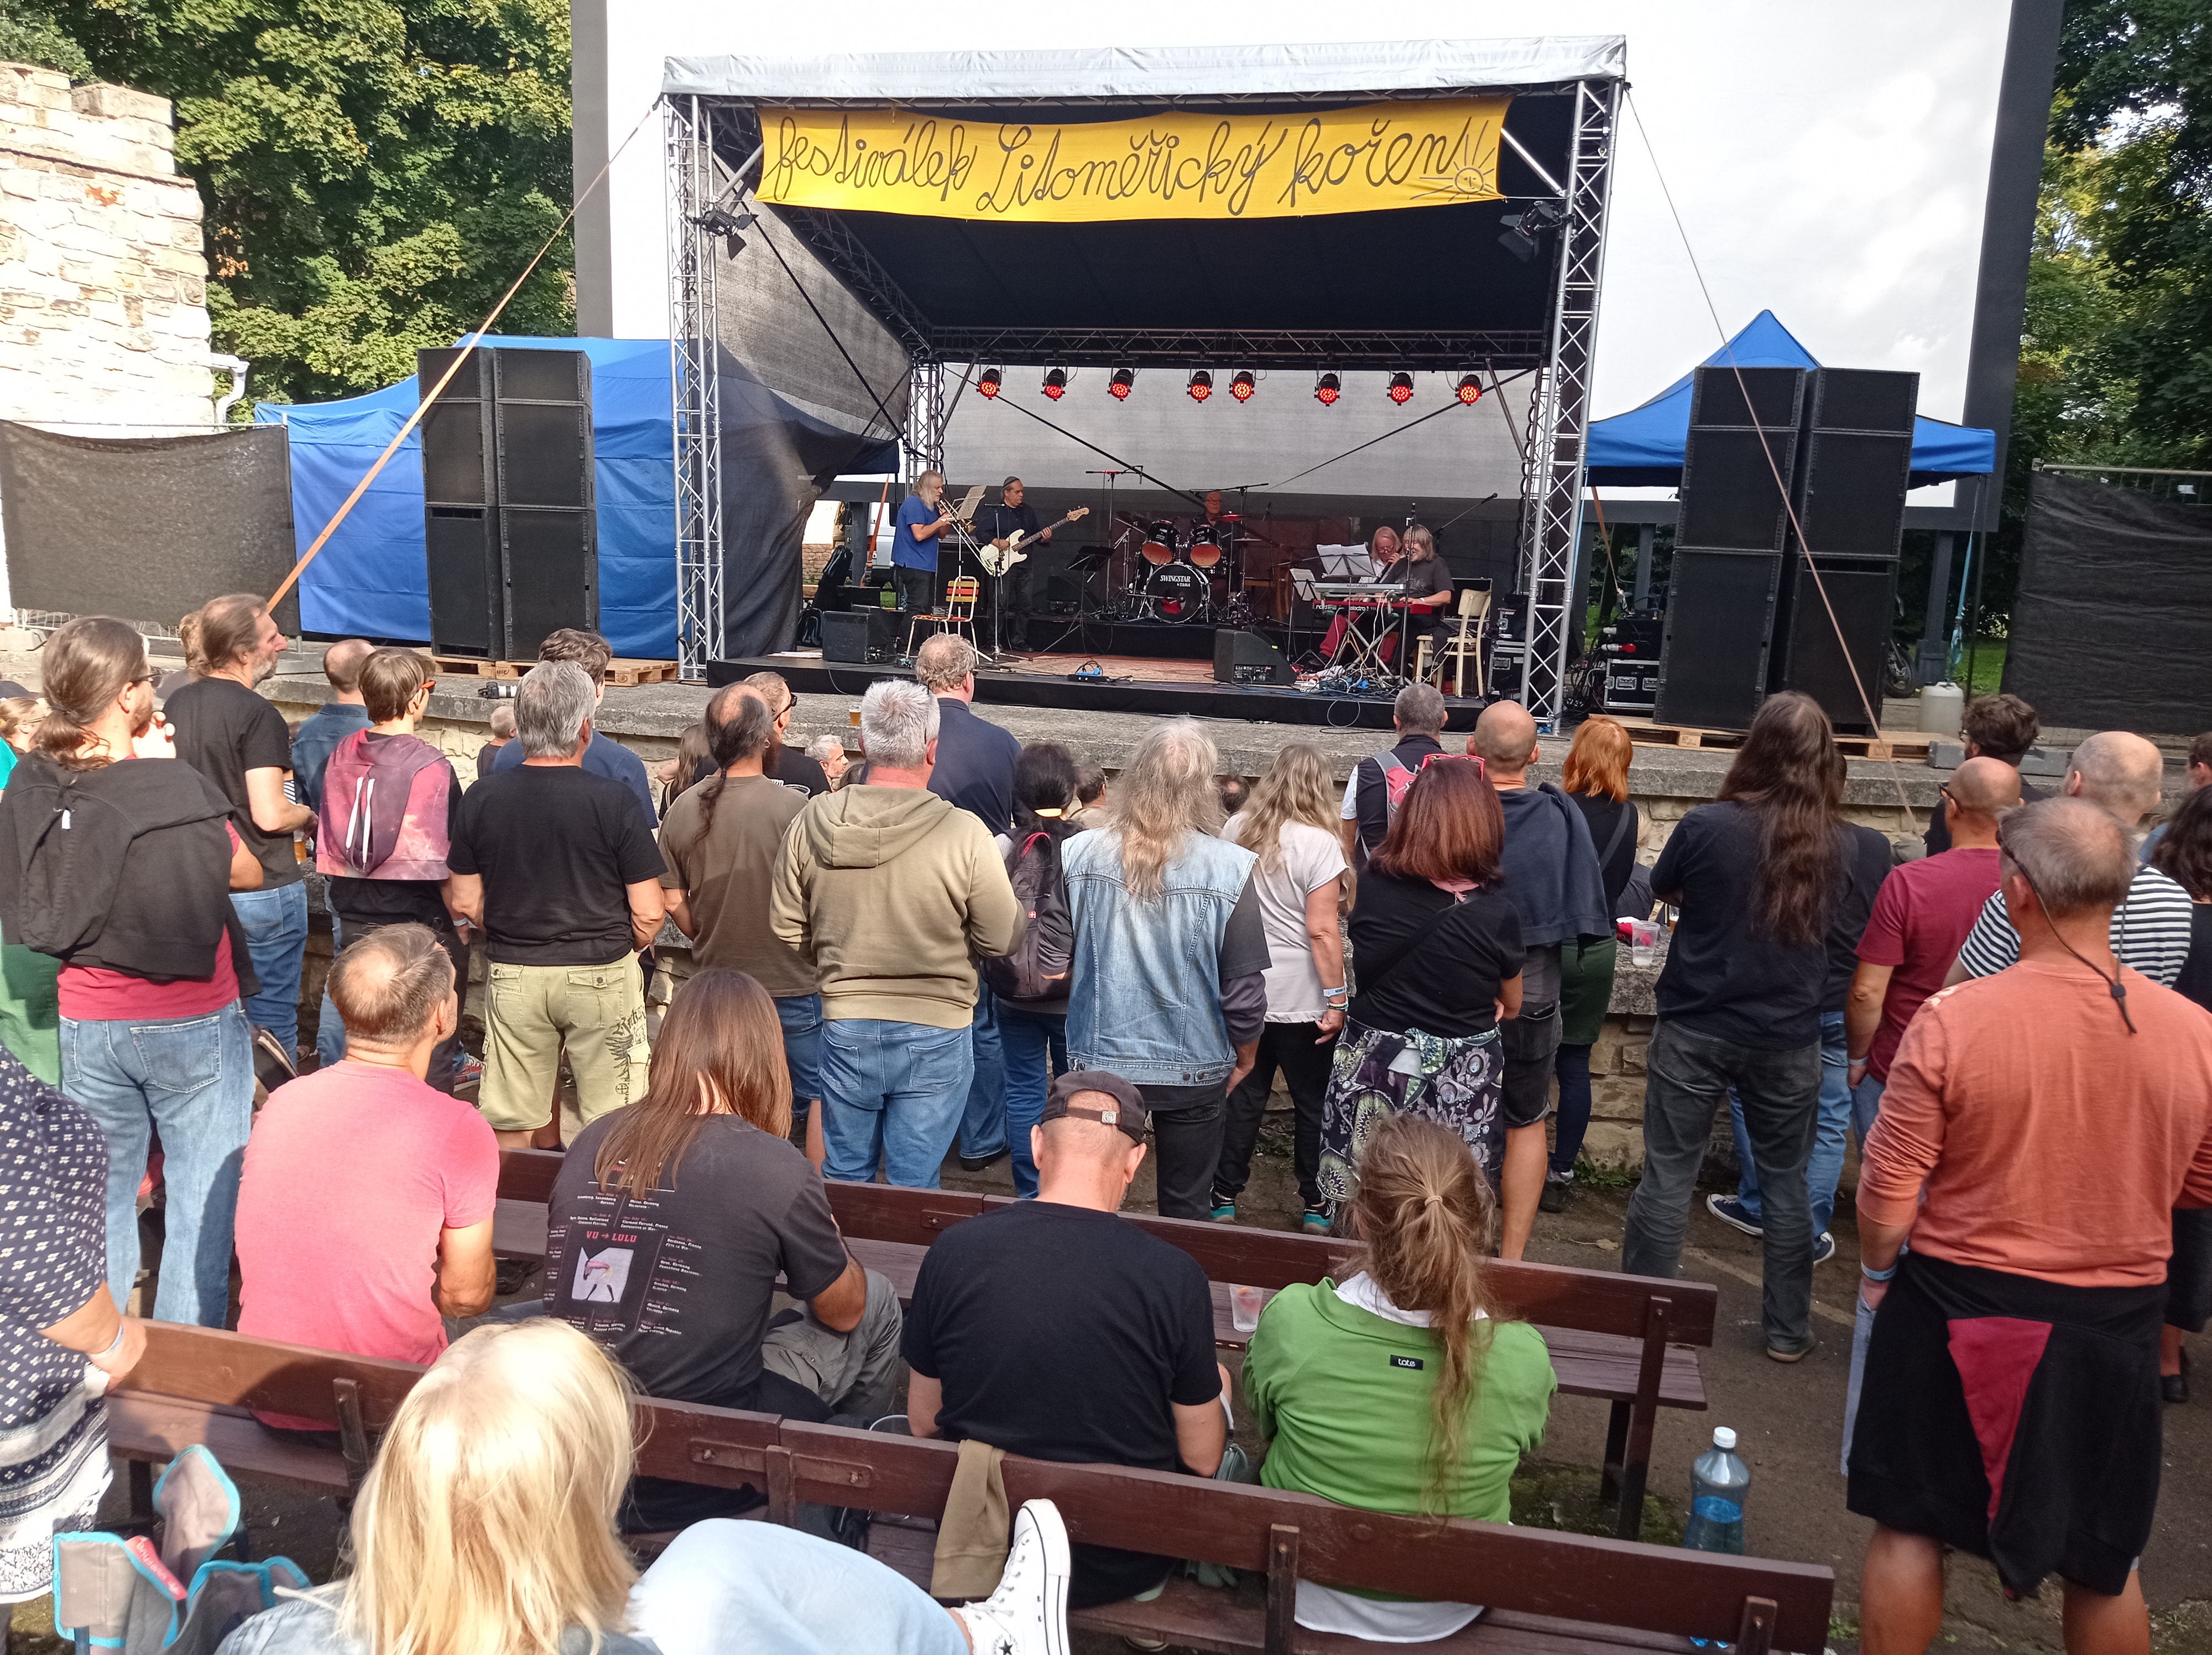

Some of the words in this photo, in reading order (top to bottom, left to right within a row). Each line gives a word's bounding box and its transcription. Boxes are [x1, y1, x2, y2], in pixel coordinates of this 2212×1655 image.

[764, 113, 977, 201] festiválek
[976, 121, 1288, 215] Litoměřický
[586, 1231, 599, 1239] VU
[612, 1234, 638, 1242] LULU
[1398, 1358, 1416, 1367] tate
